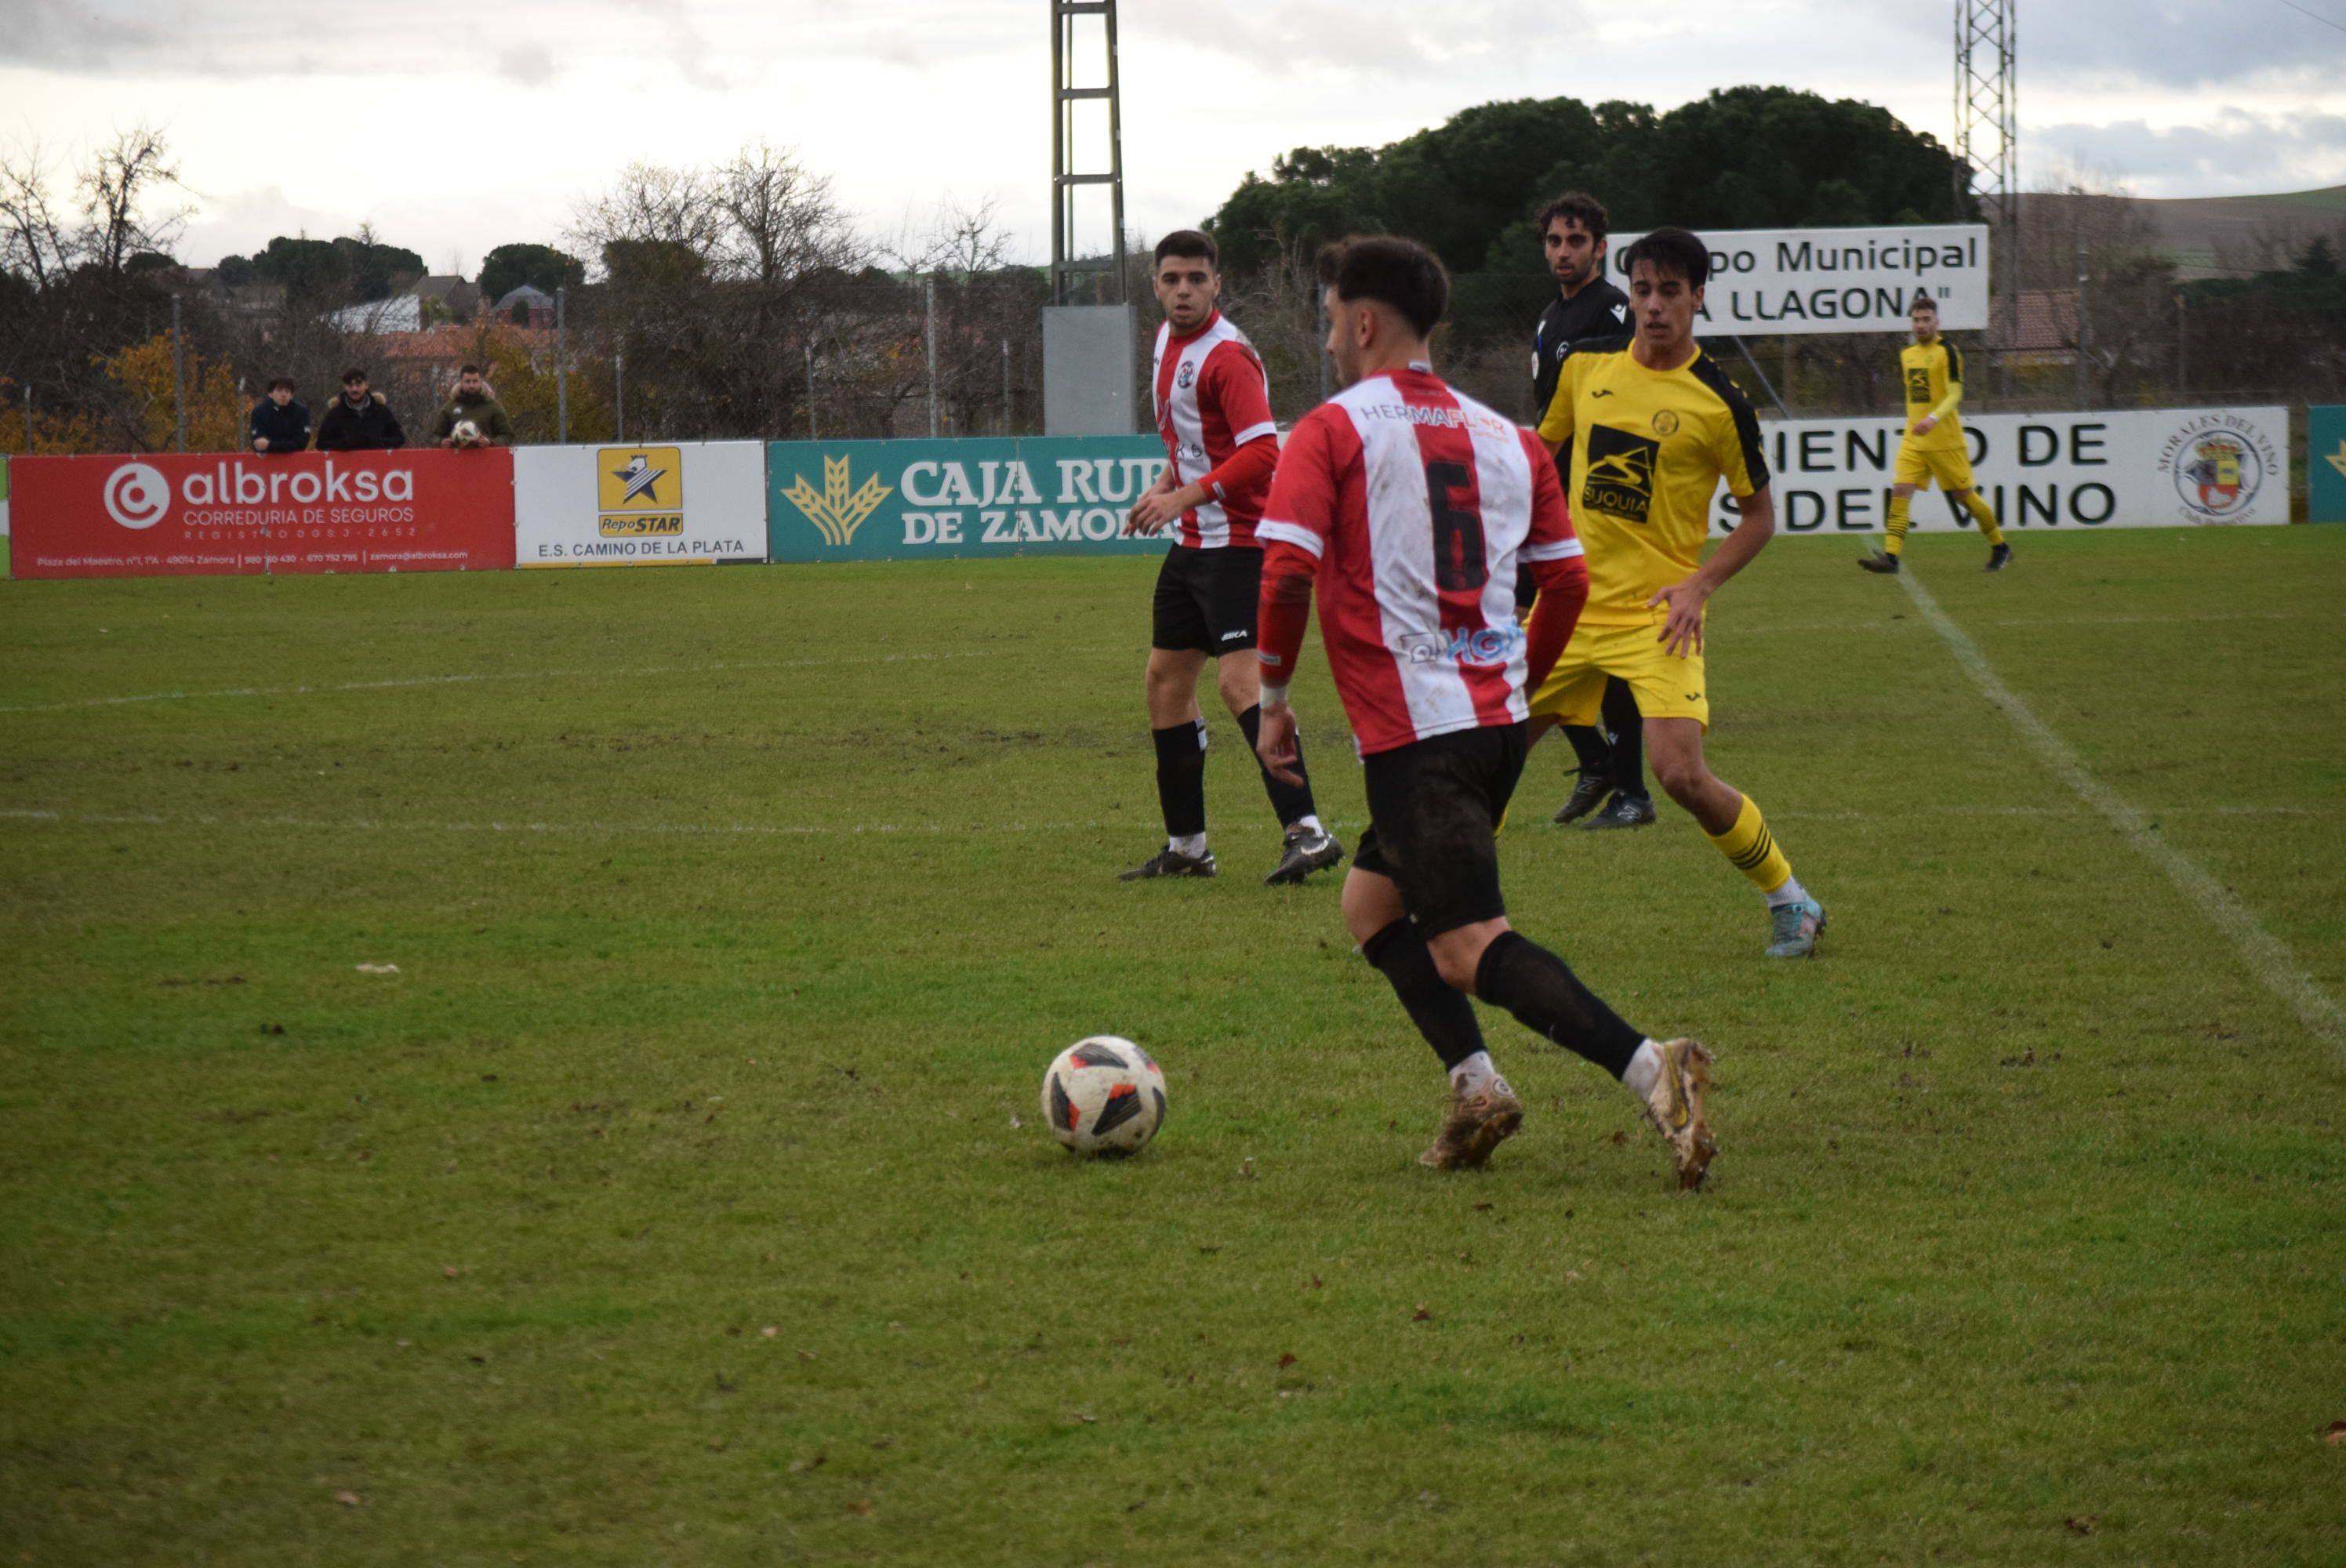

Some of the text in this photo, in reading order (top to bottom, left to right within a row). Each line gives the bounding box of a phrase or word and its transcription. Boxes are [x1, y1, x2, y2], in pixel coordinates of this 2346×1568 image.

[1614, 237, 1976, 282] Cpo Municipal
[2017, 423, 2108, 468] DE
[2158, 415, 2279, 476] MORALES DEL VINO
[182, 459, 413, 505] albroksa
[900, 460, 1042, 509] CAJA
[183, 508, 414, 527] CORREDURIA DE SEGUROS
[183, 529, 288, 540] REGISTRO
[601, 517, 681, 533] RepoSTAR
[902, 512, 964, 545] DE
[1426, 462, 1489, 590] 6
[38, 557, 64, 567] Plaza
[65, 557, 80, 566] del
[197, 554, 234, 565] Zamora
[369, 550, 468, 562] zamora@albroksa.com
[538, 539, 745, 557] E.S. CAMINO DE LA PLATA
